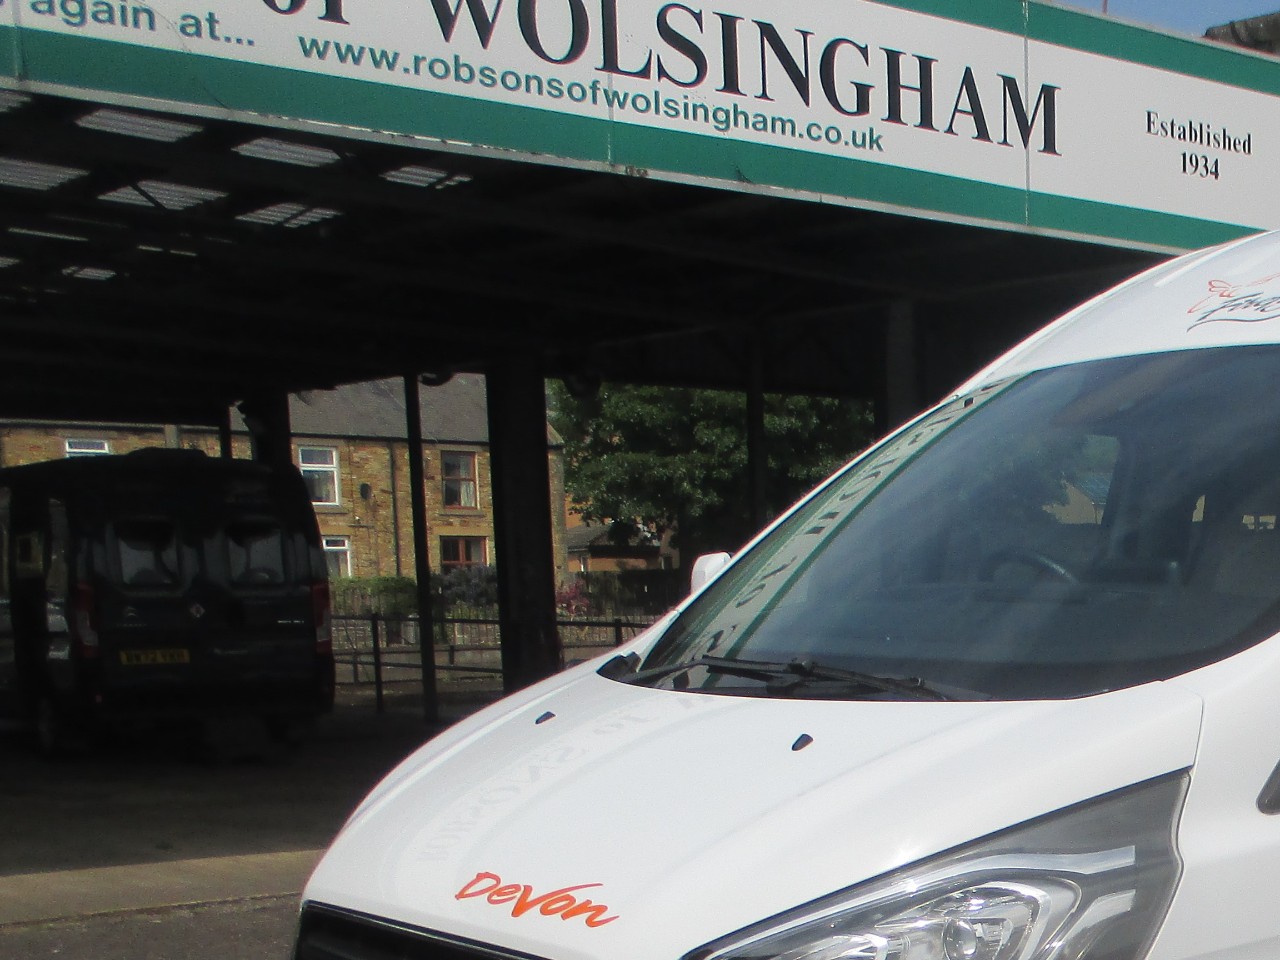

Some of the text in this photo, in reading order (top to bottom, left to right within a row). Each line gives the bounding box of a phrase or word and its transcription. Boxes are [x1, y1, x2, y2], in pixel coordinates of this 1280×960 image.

[29, 0, 156, 32] again
[297, 35, 885, 153] www.robsonsofwolsingham.co.uk
[1145, 109, 1252, 155] Established
[1181, 151, 1220, 180] 1934
